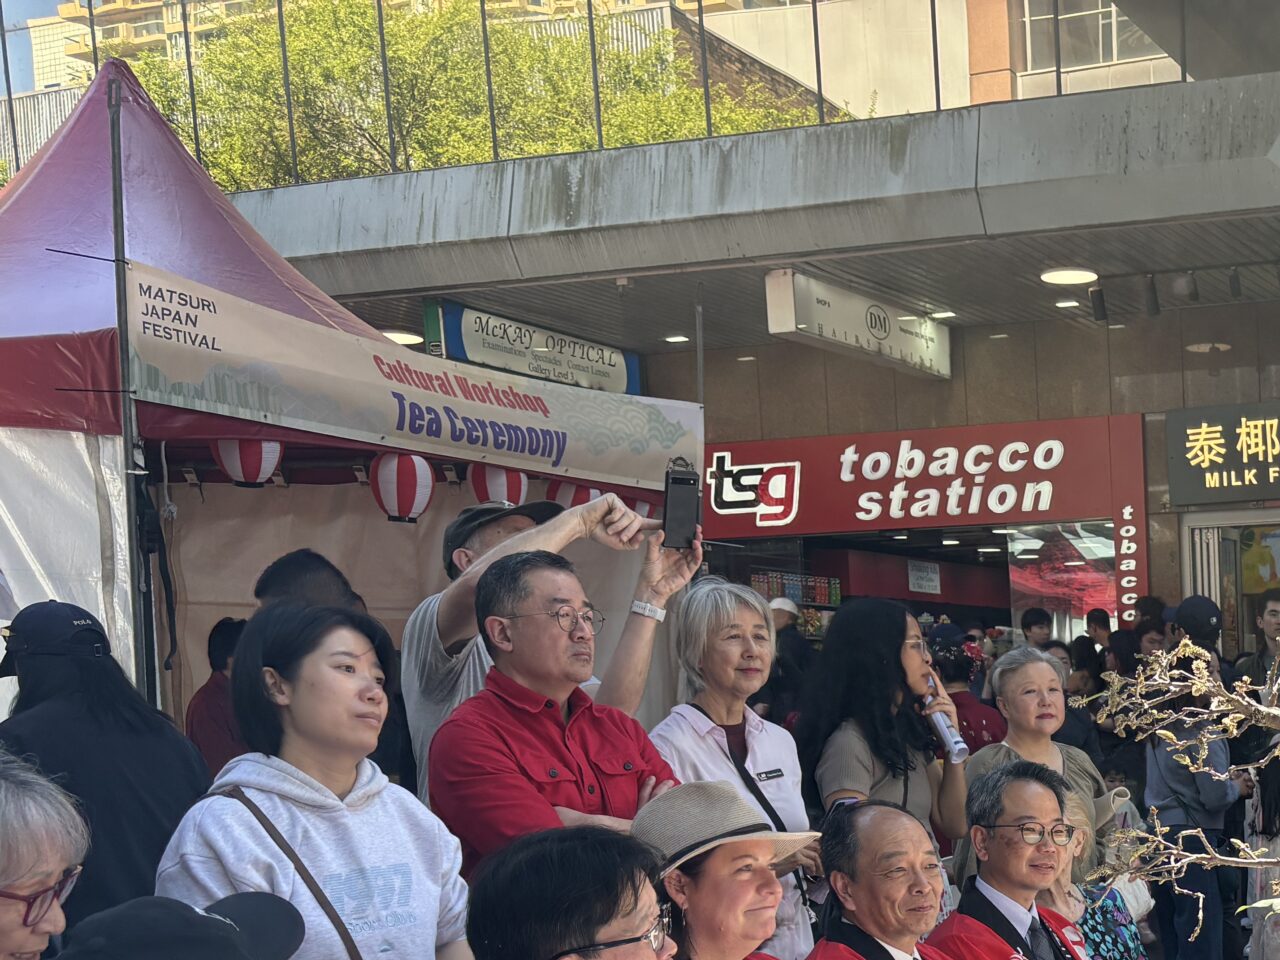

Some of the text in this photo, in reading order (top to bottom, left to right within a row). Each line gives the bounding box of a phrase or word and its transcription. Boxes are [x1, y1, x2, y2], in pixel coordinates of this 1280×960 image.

[138, 283, 217, 314] MATSURI
[141, 303, 198, 328] JAPAN
[142, 321, 222, 352] FESTIVAL
[474, 316, 617, 367] McKAY OPTICAL
[869, 311, 887, 334] DM
[482, 338, 611, 379] Examinations Spectacles Contact Lenses
[528, 362, 551, 378] Gallery
[553, 370, 570, 380] Level
[373, 355, 550, 418] Cultural Workshop
[392, 390, 567, 468] Tea Ceremony
[840, 440, 1065, 483] tobacco
[1205, 469, 1258, 488] MILK
[708, 453, 800, 526] tsg
[855, 475, 1054, 521] station
